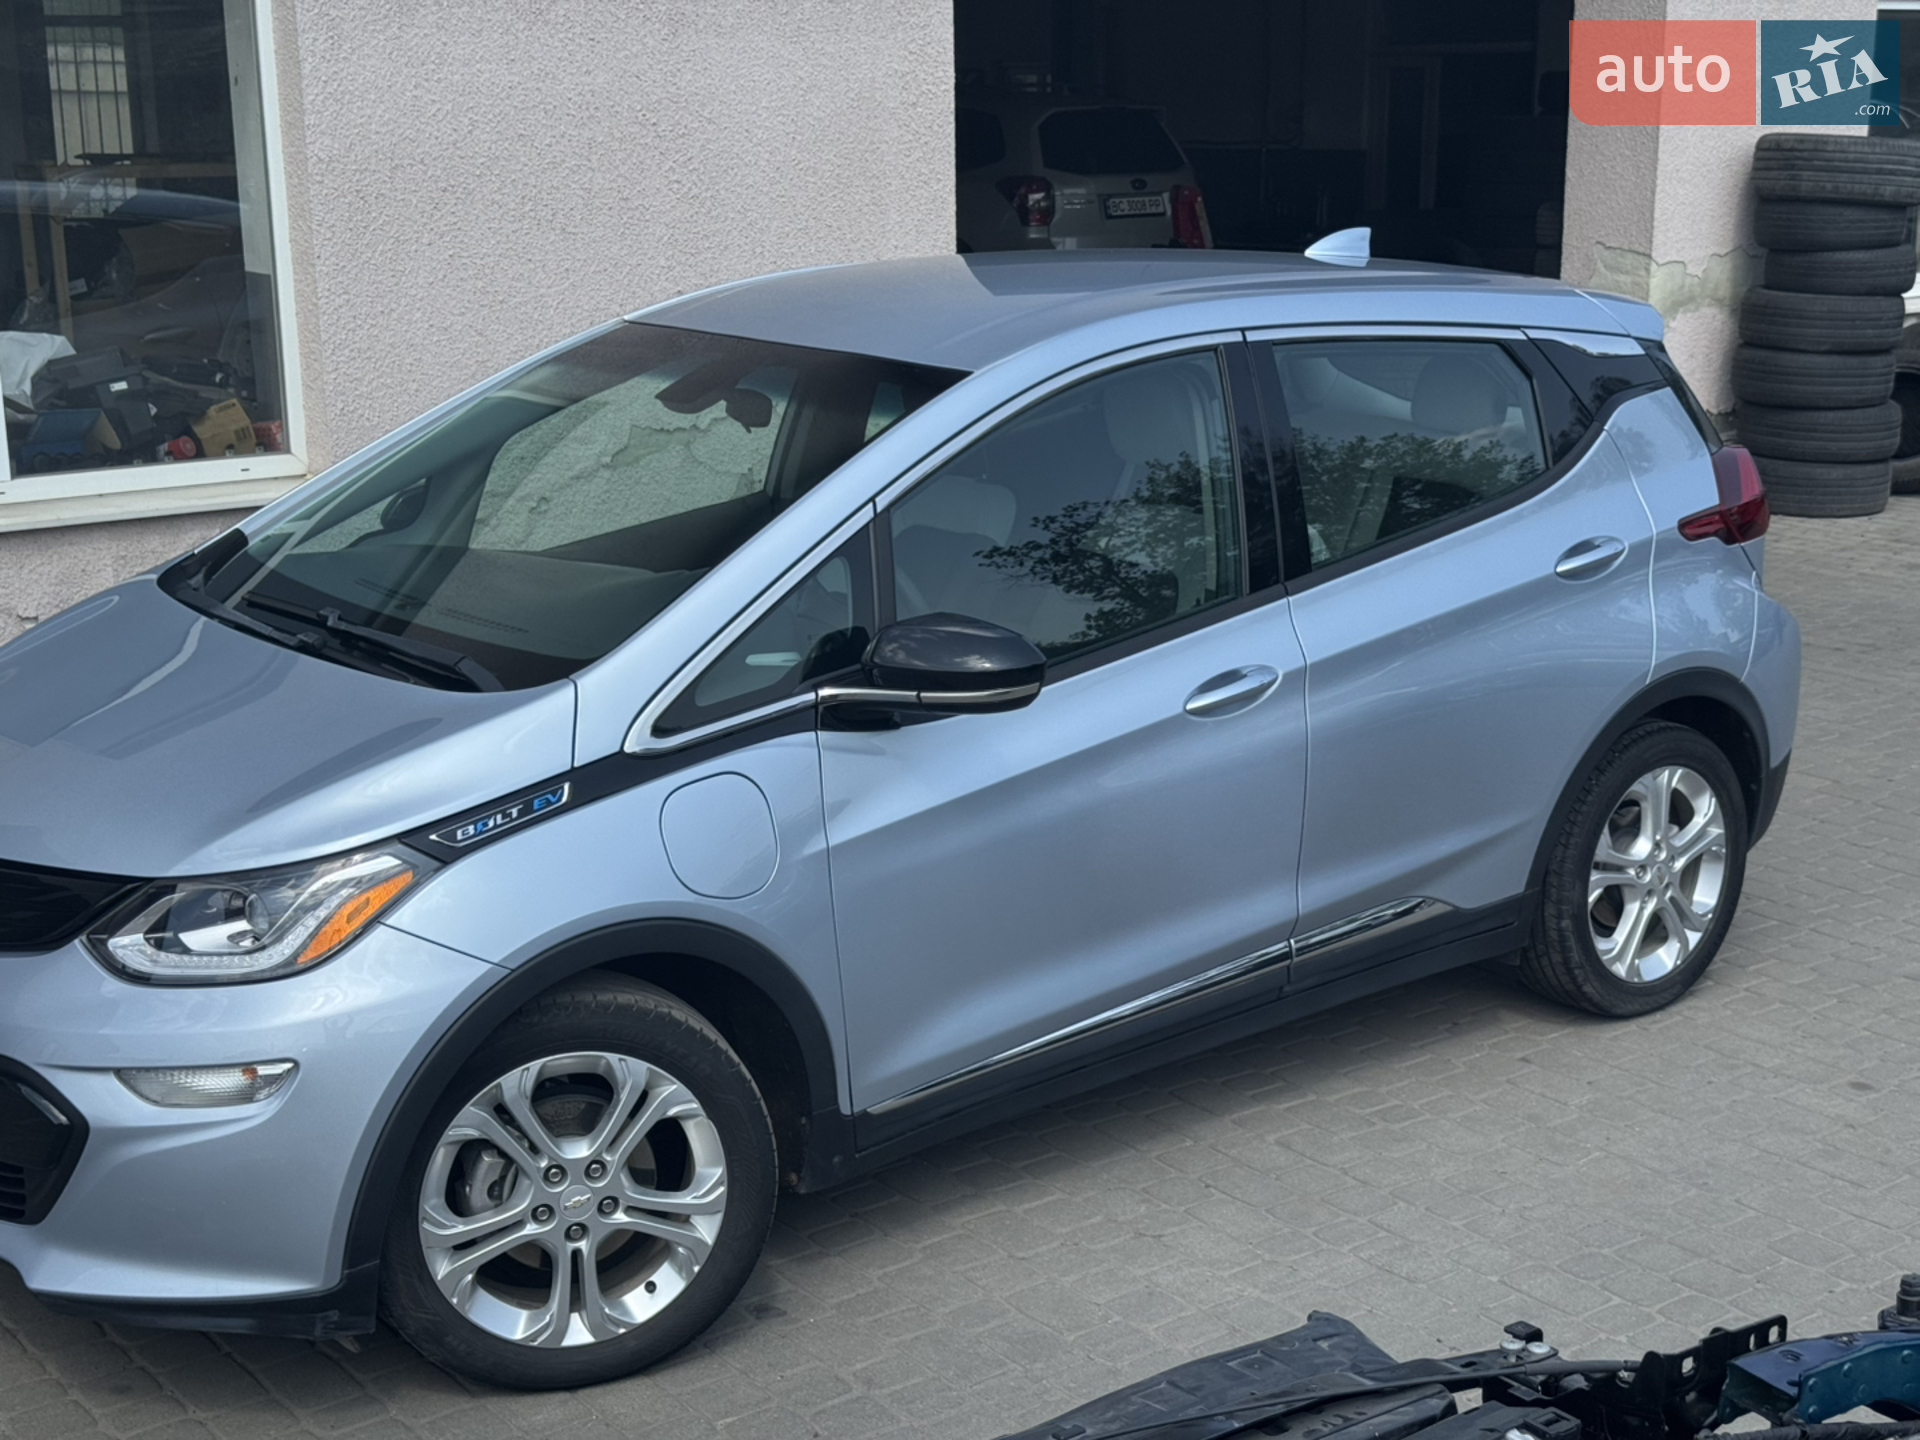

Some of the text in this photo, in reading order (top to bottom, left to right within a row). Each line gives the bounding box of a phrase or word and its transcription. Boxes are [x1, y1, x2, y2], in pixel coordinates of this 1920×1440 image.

[1111, 200, 1125, 213] BC
[456, 789, 563, 841] BOLT EV
